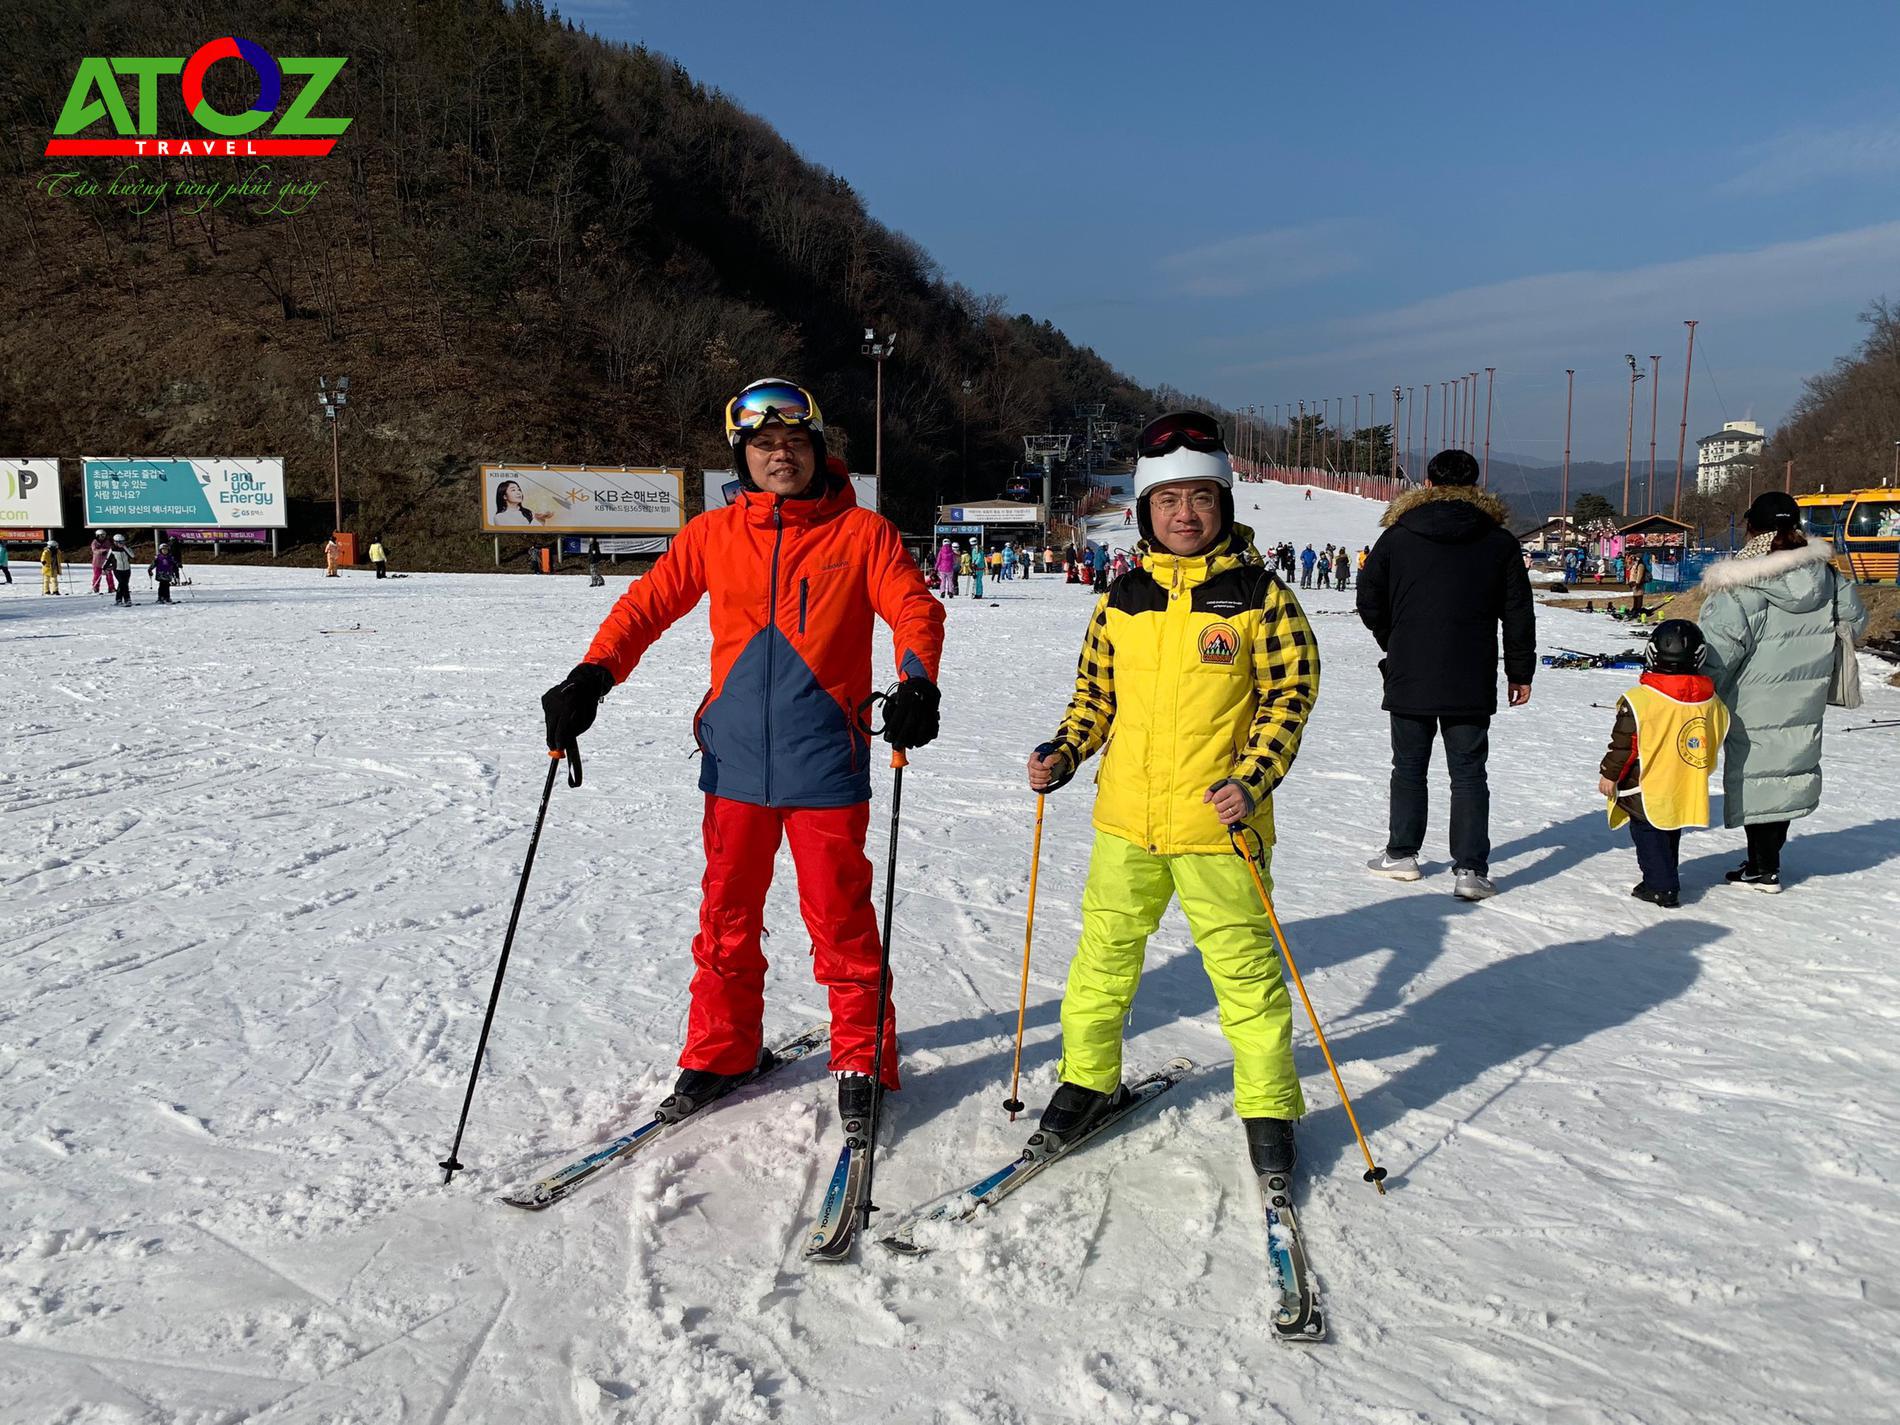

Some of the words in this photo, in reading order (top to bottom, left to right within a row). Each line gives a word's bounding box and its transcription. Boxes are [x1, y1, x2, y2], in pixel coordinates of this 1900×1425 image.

[224, 470, 227, 481] I
[231, 481, 266, 493] your
[220, 491, 273, 505] Energy
[594, 490, 618, 502] KB
[620, 491, 670, 503] 손해보험
